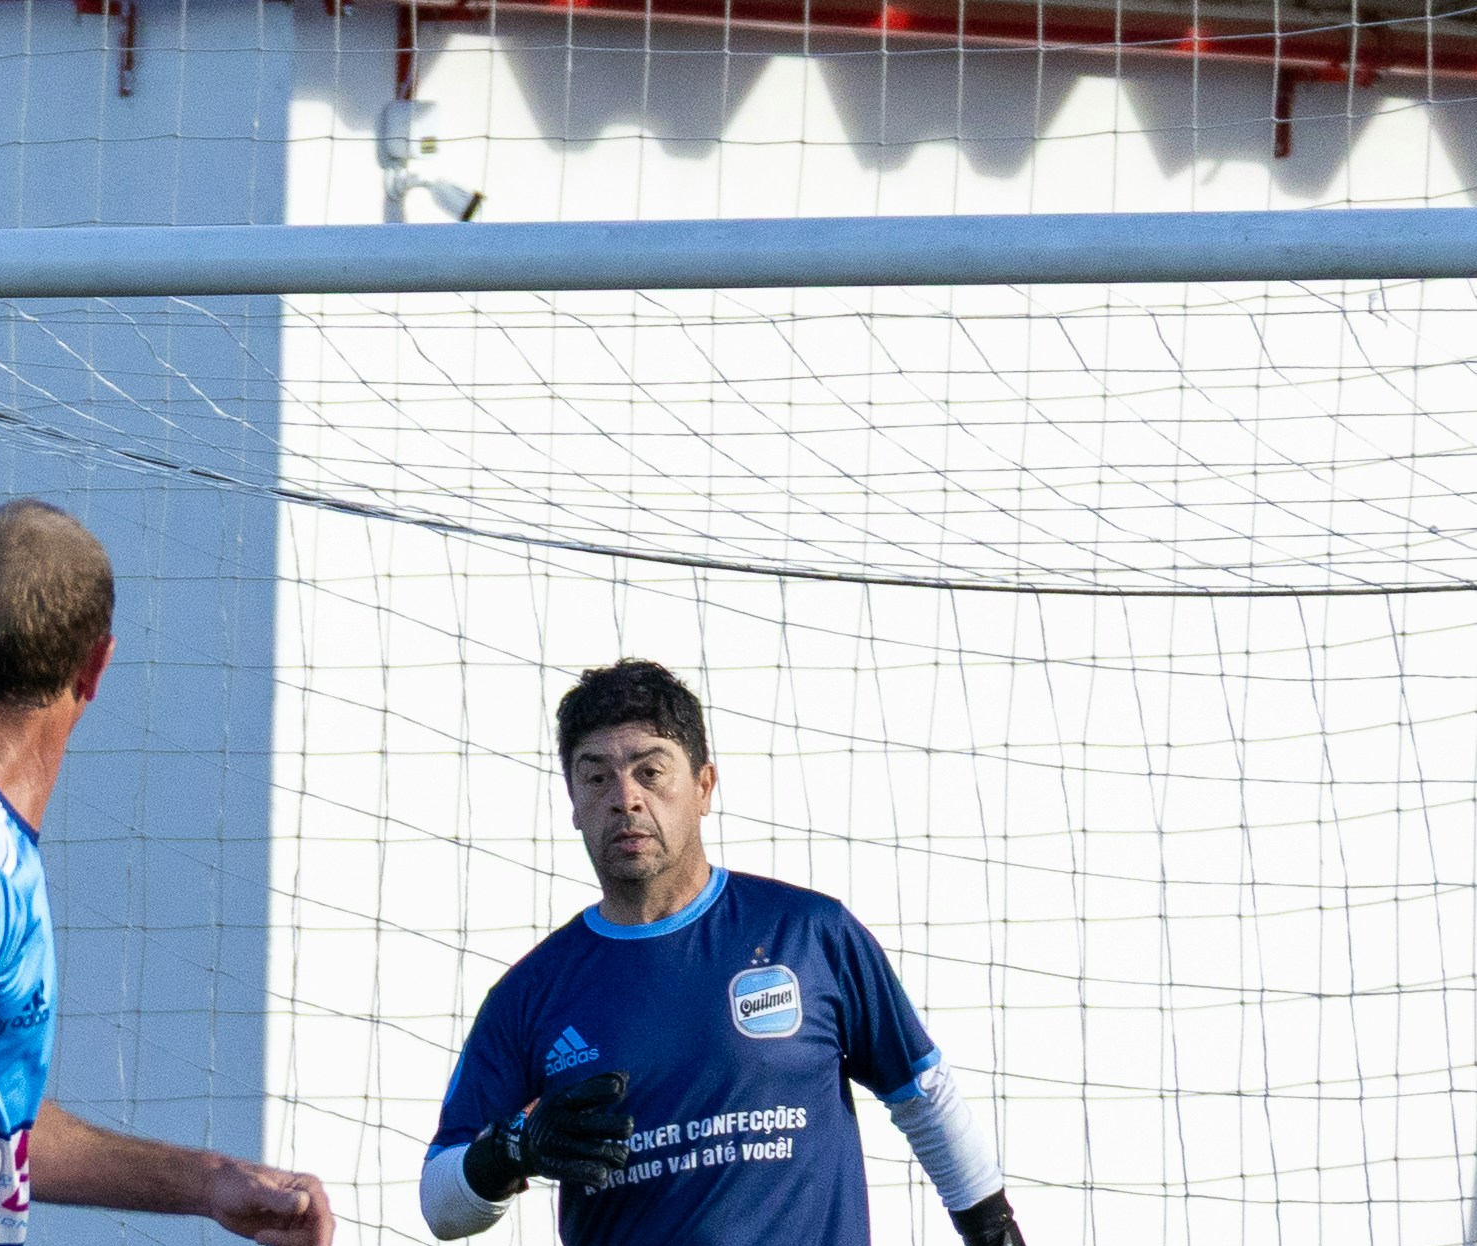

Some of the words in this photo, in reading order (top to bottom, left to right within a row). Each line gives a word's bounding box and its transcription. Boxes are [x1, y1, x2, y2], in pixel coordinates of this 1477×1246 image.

[740, 990, 793, 1018] Quilmes
[545, 1043, 599, 1076] adidas
[687, 1105, 807, 1141] CONFECÇÕES
[628, 1160, 662, 1184] que
[667, 1148, 696, 1175] vai
[702, 1140, 736, 1167] até
[742, 1138, 793, 1162] você!
